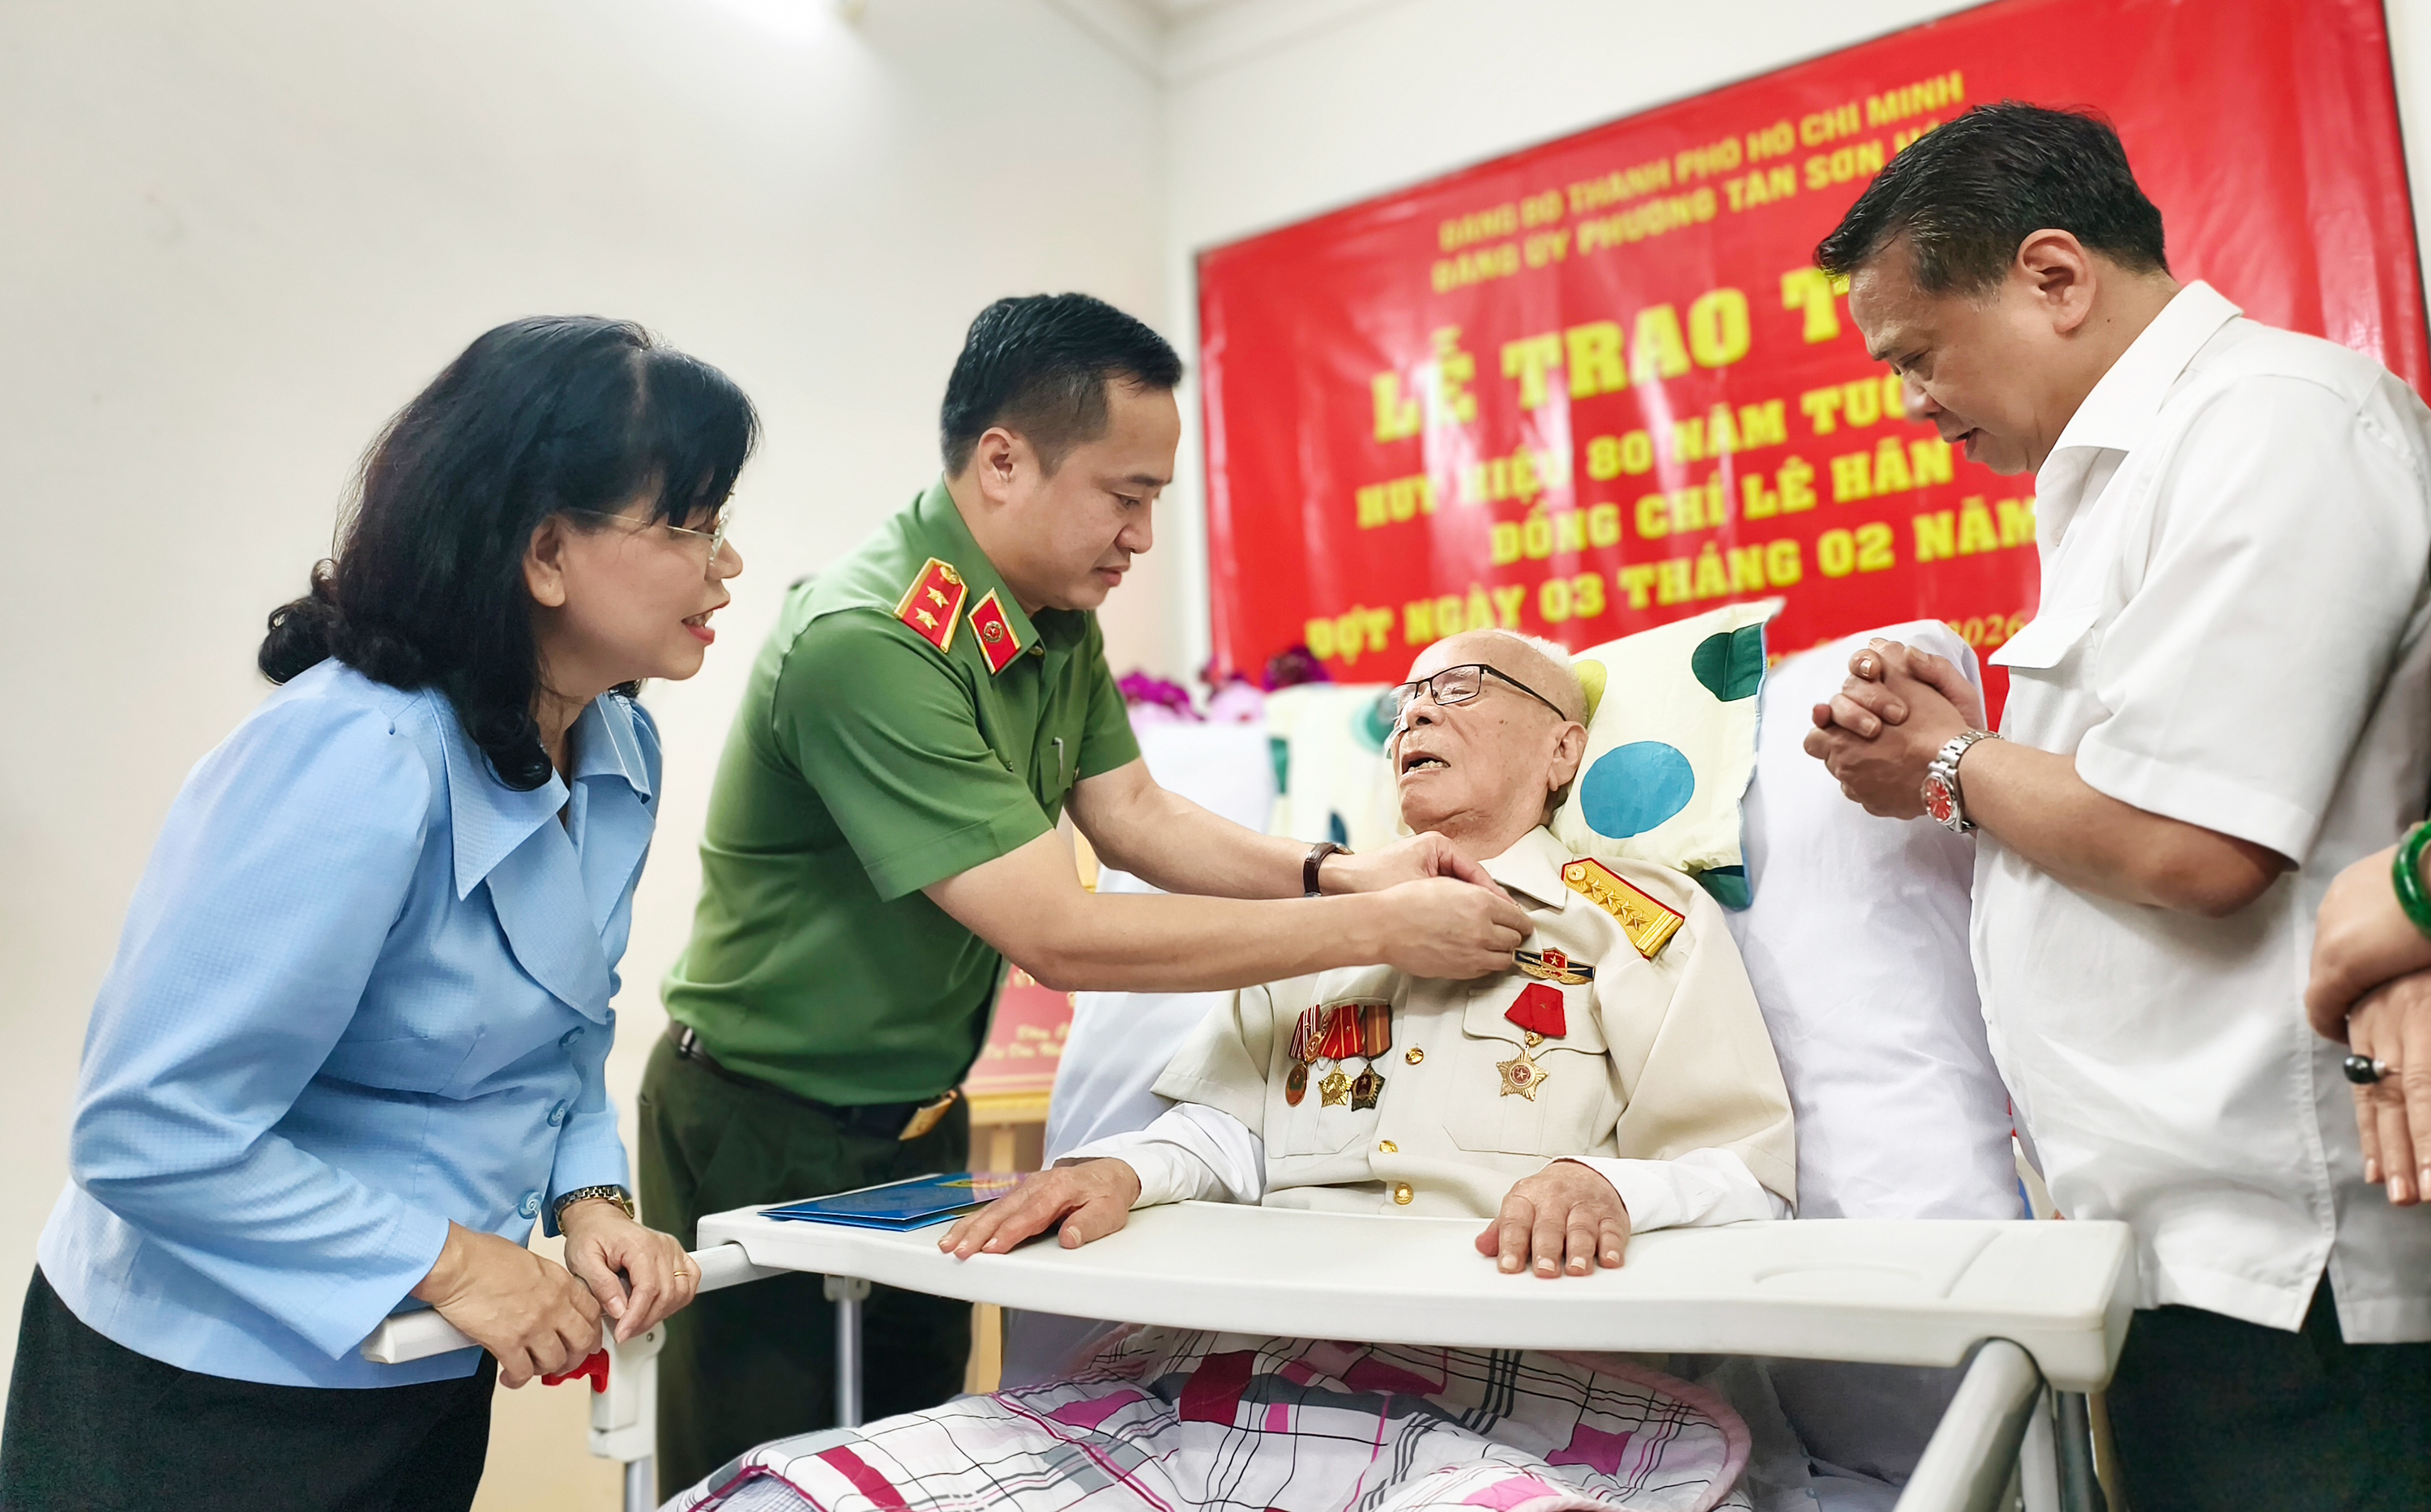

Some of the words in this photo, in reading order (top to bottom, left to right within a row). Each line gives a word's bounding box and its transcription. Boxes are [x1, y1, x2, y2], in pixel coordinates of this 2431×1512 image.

[1866, 70, 1965, 128] MINH
[1502, 288, 1750, 409] TRAO
[1356, 475, 1441, 530] HUY
[1460, 444, 1566, 506] HIỆU
[1587, 429, 1654, 481] 80
[1671, 400, 1788, 464] NĂM
[1635, 474, 1728, 540] CHÍ
[1743, 456, 1818, 520] LÊ
[1305, 604, 1395, 666] ĐỢT
[1403, 582, 1526, 646] NGÀY
[1539, 571, 1607, 624] 03
[1619, 540, 1802, 610] THÁNG
[1818, 522, 1895, 579] 02
[1912, 496, 2036, 563] NĂM
